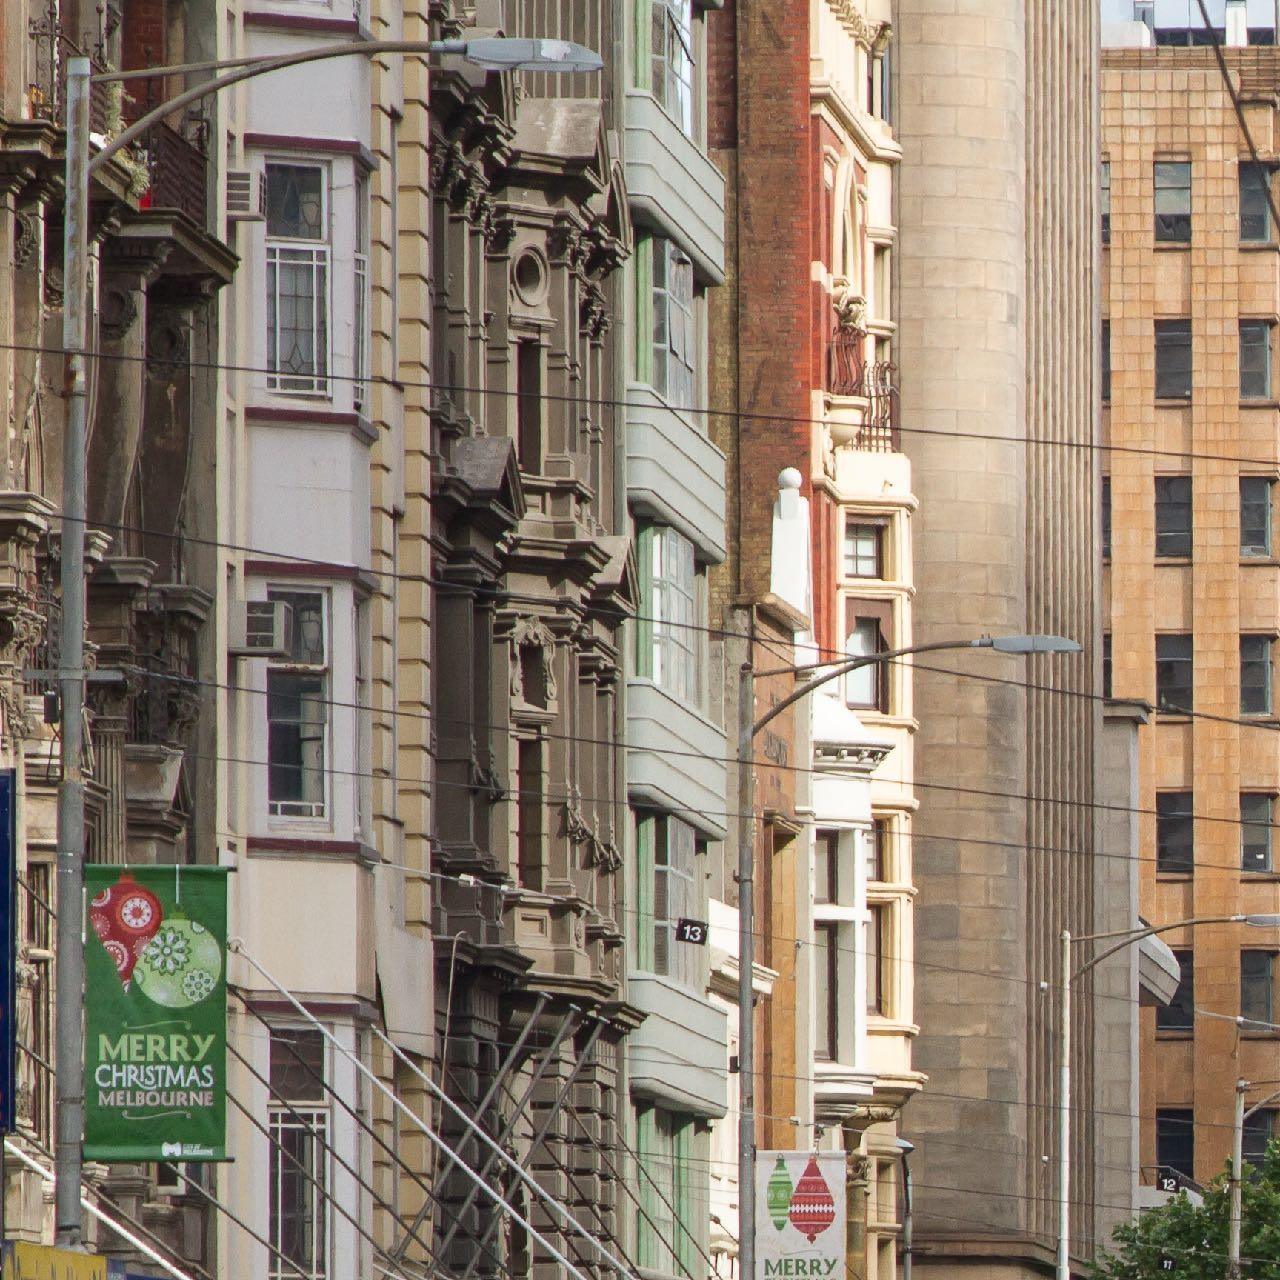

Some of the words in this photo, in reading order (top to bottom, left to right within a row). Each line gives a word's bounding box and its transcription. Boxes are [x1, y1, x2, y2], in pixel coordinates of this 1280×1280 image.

[683, 925, 702, 942] 13
[98, 1033, 216, 1062] MERRY
[95, 1064, 214, 1090] CHRISTMAS
[98, 1090, 214, 1107] MELBOURNE
[764, 1257, 838, 1276] MERRY
